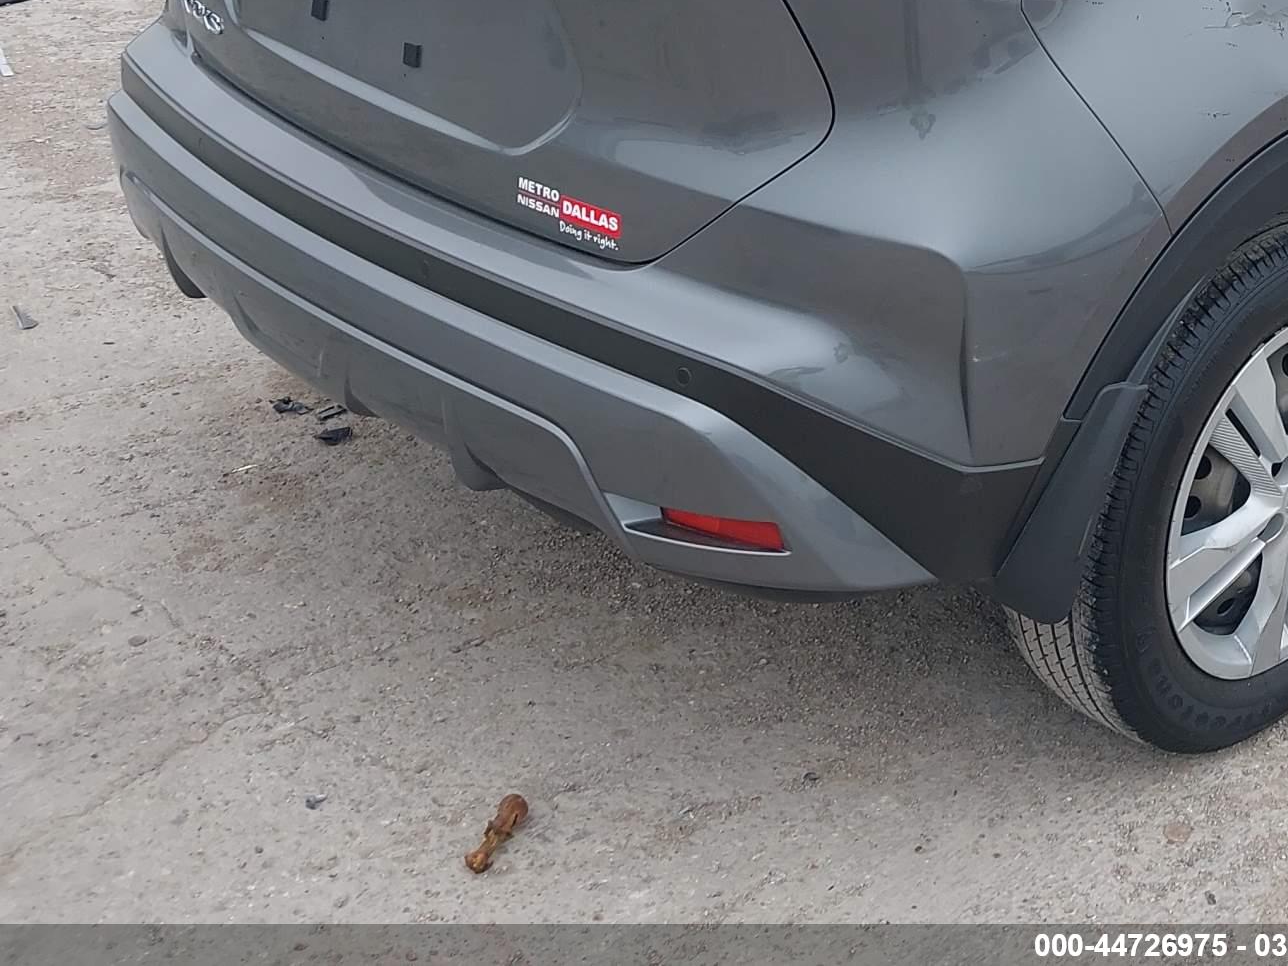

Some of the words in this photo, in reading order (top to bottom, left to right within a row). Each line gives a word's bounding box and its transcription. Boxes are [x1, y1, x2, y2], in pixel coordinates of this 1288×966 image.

[518, 177, 560, 202] METRO
[517, 194, 560, 218] NISSAN
[562, 200, 618, 231] DALLAS
[559, 220, 583, 241] Doing
[583, 229, 593, 241] it
